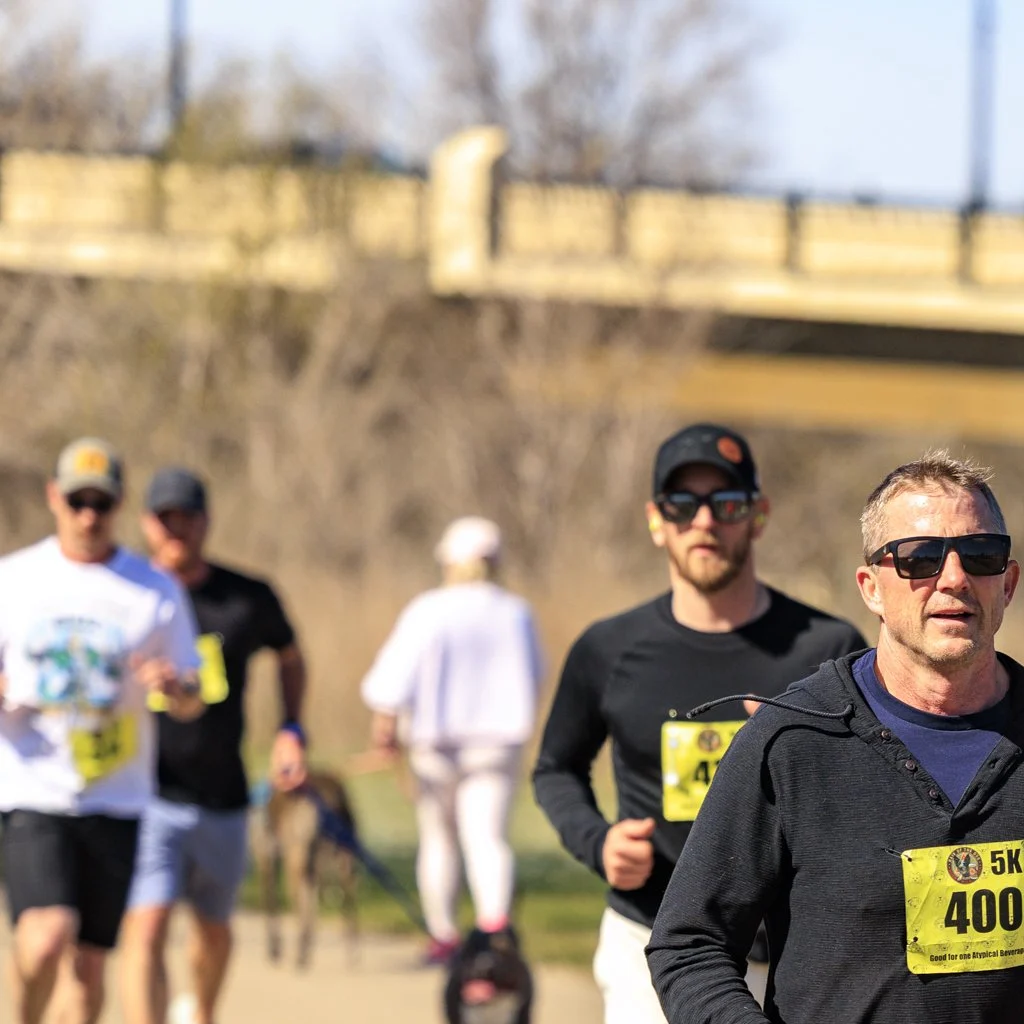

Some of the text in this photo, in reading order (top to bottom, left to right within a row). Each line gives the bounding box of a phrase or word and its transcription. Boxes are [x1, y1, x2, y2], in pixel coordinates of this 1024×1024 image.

[990, 848, 1023, 876] 5K
[944, 886, 1023, 935] 400
[929, 953, 947, 962] Good
[948, 953, 958, 961] for
[959, 952, 971, 960] one
[972, 949, 999, 960] Atypical
